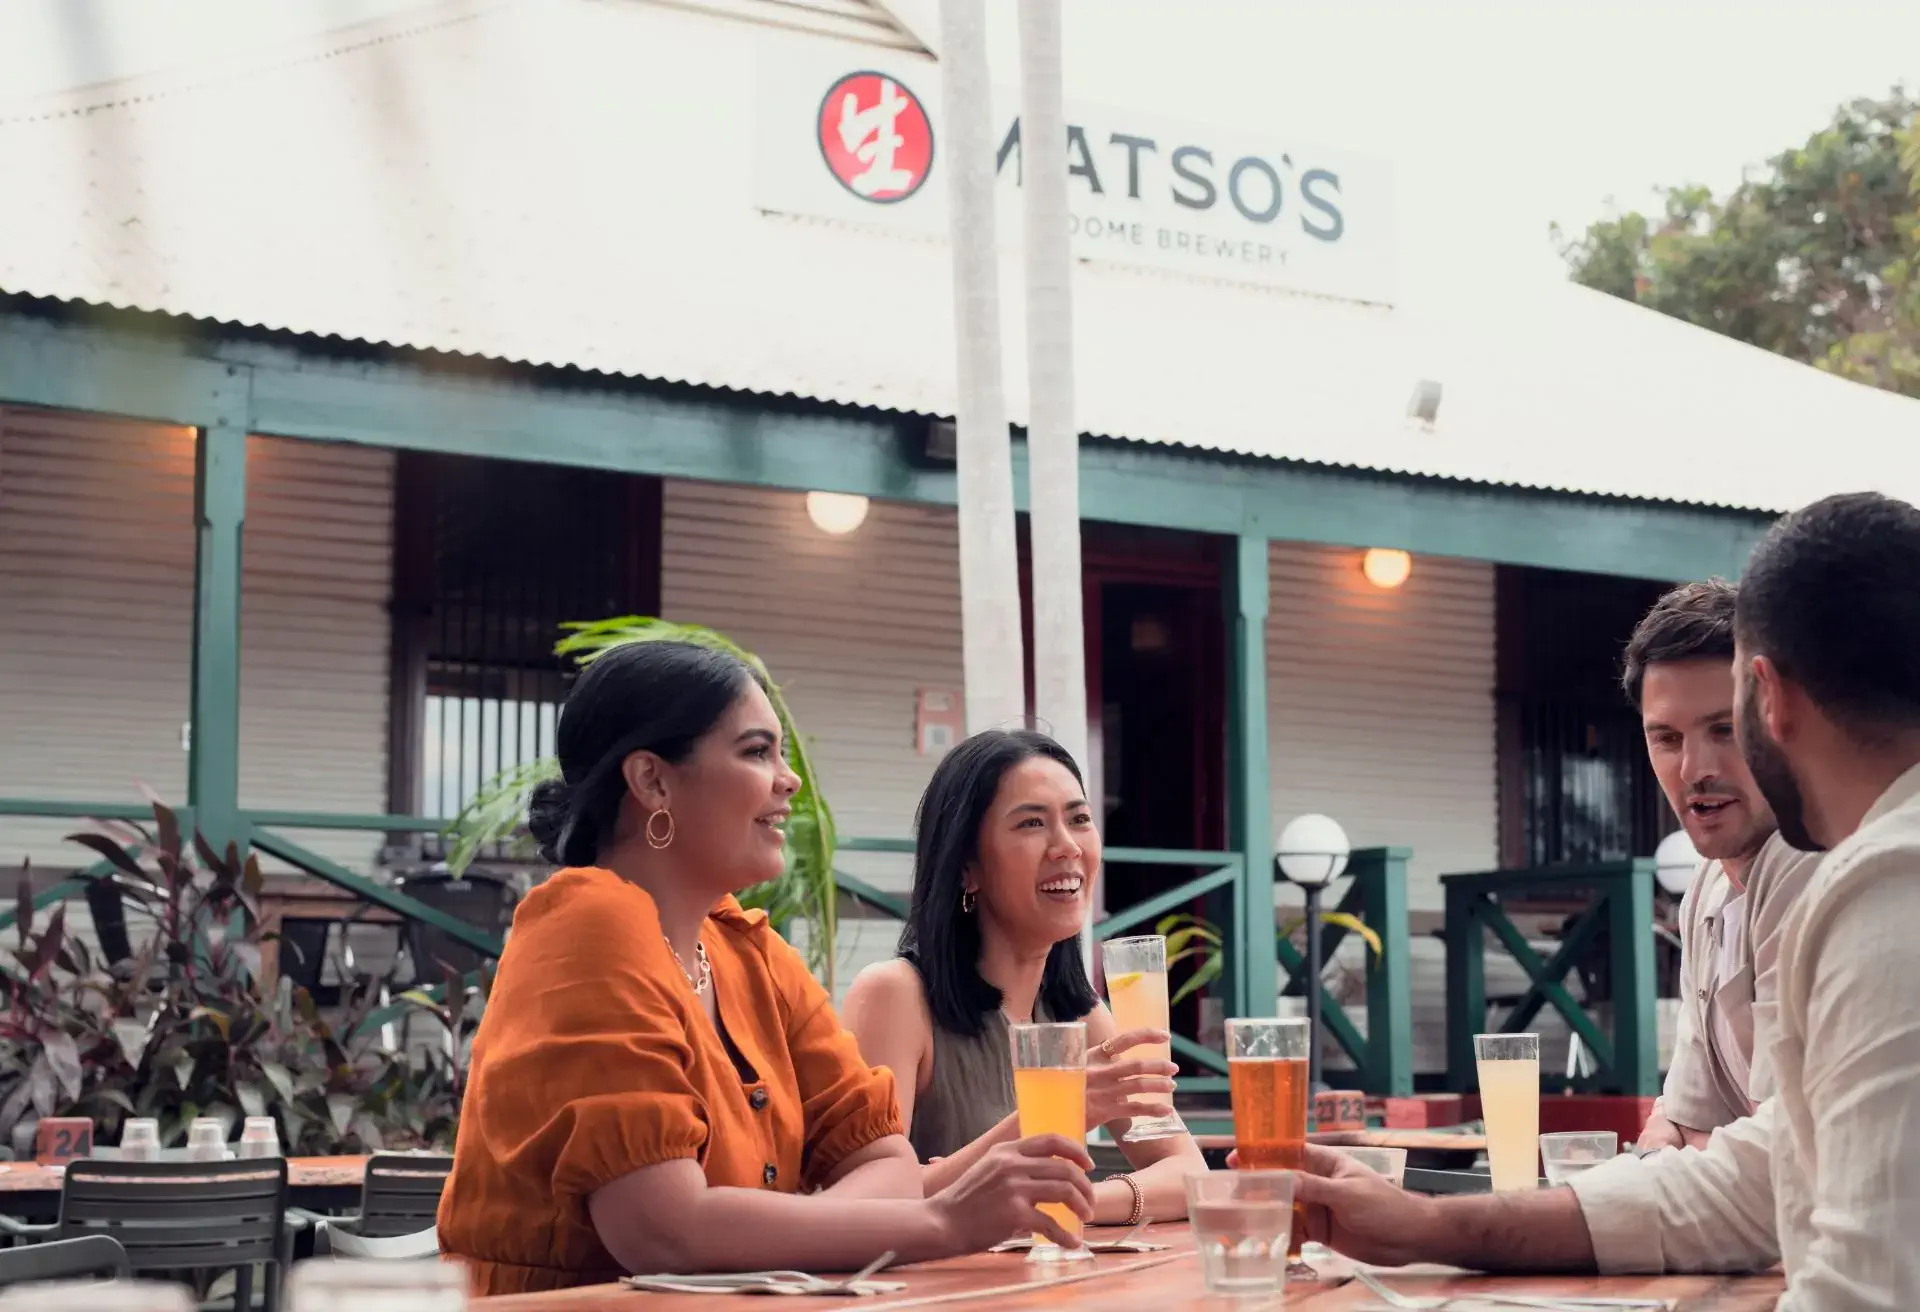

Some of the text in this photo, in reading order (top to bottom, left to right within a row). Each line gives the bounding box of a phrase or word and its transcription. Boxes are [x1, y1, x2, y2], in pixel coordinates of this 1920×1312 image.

[1066, 212, 1293, 266] OOME BREWERY
[54, 1128, 90, 1157] 24
